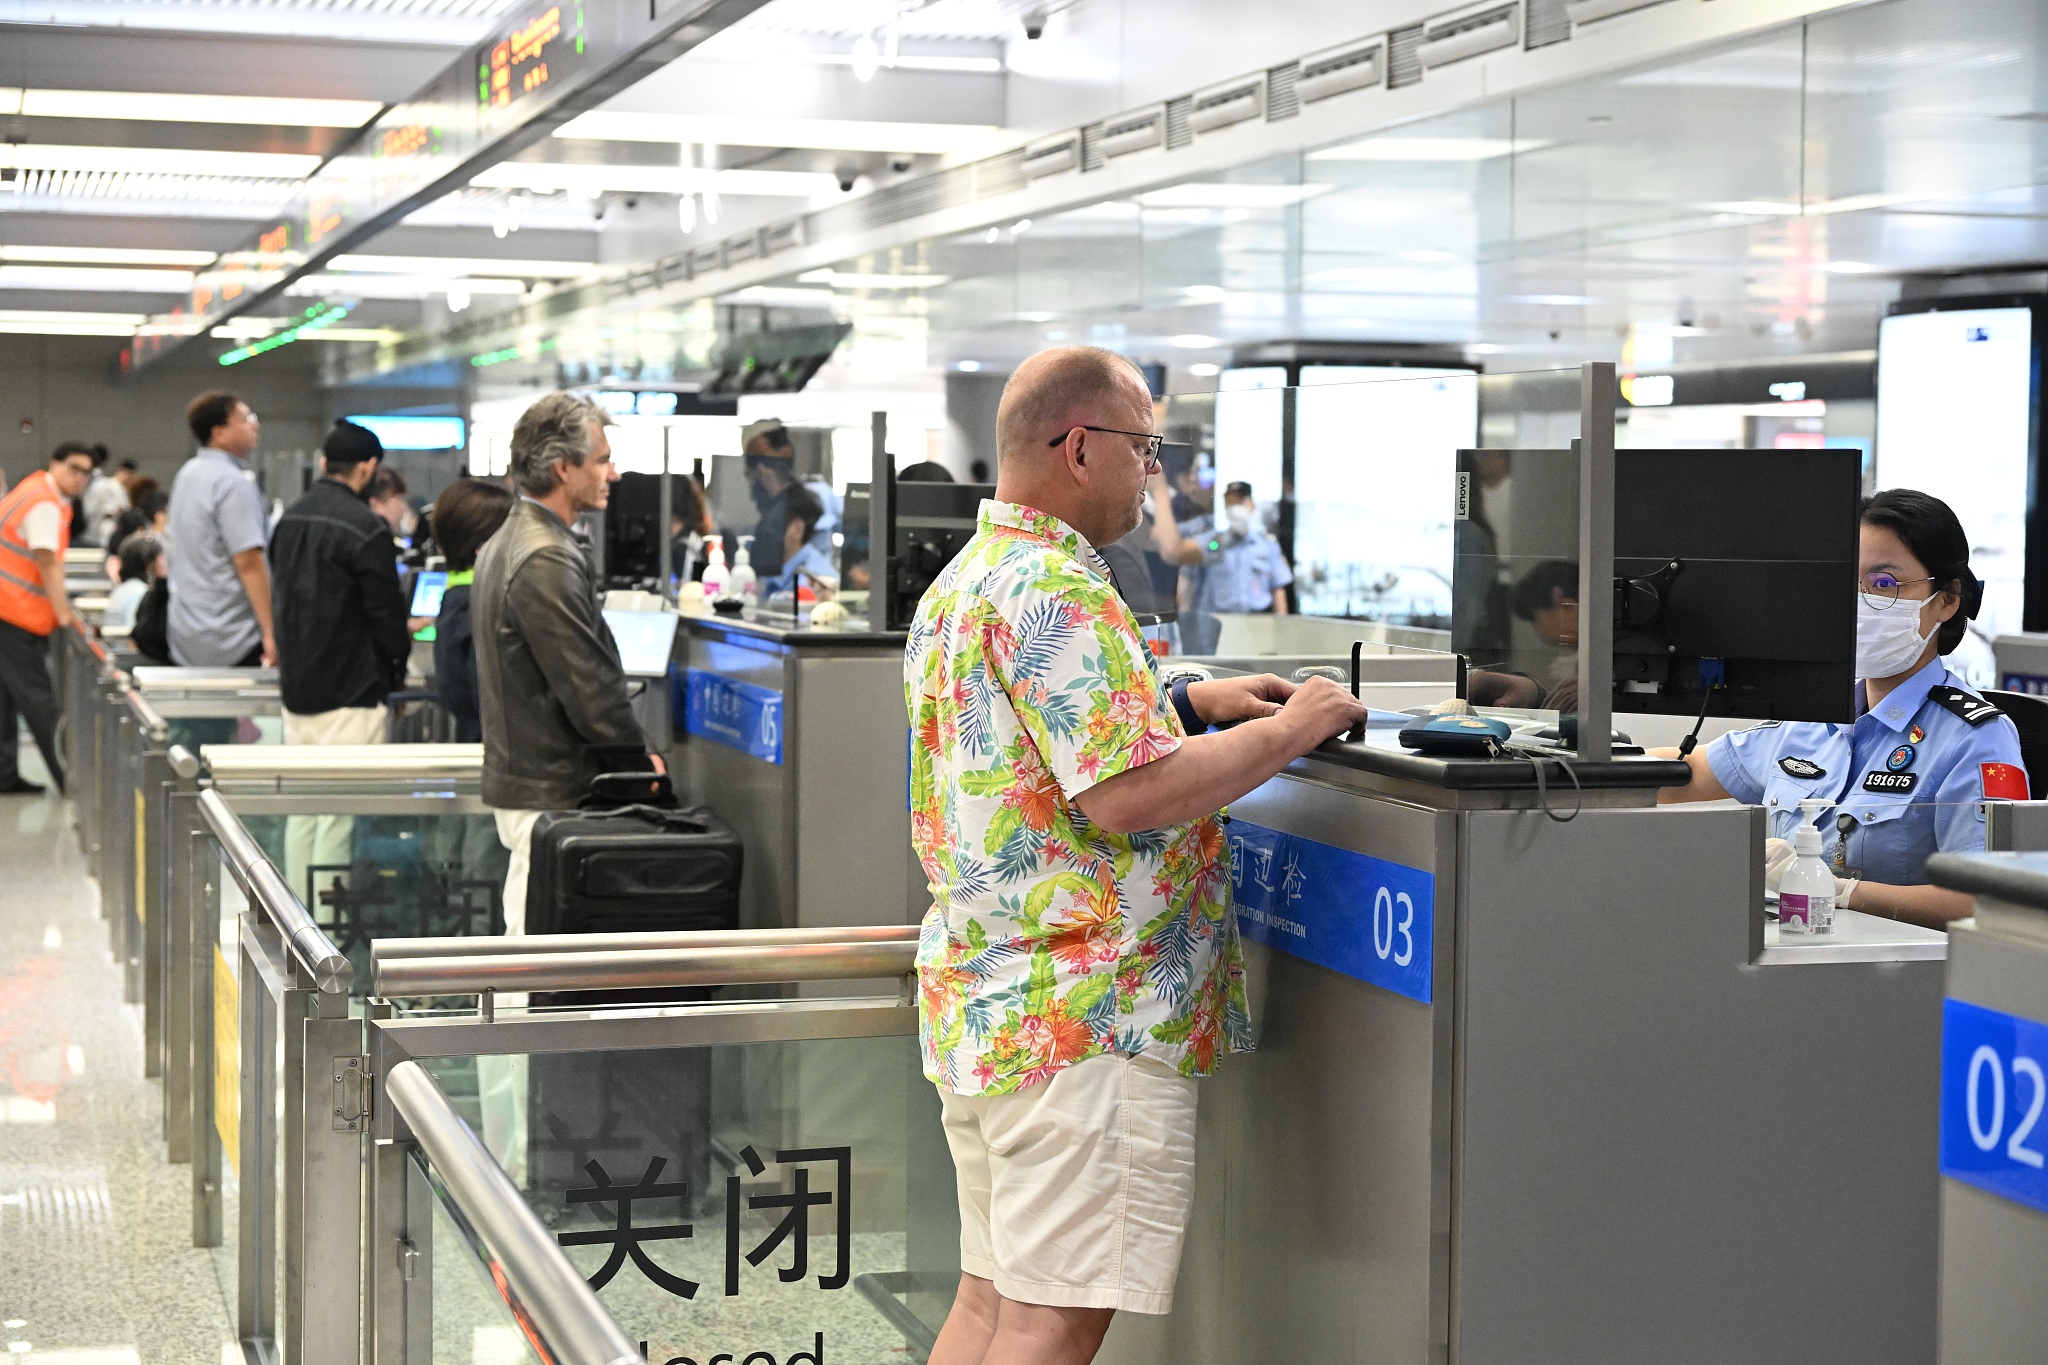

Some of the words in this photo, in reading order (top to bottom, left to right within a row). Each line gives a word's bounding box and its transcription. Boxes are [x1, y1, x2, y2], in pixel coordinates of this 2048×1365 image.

[1457, 475, 1467, 516] Lenovo
[1866, 773, 1912, 787] 191675
[1266, 913, 1306, 939] INSPECTION
[1373, 886, 1414, 967] 03
[1967, 1045, 2046, 1168] 02
[557, 1144, 852, 1301] 关闭
